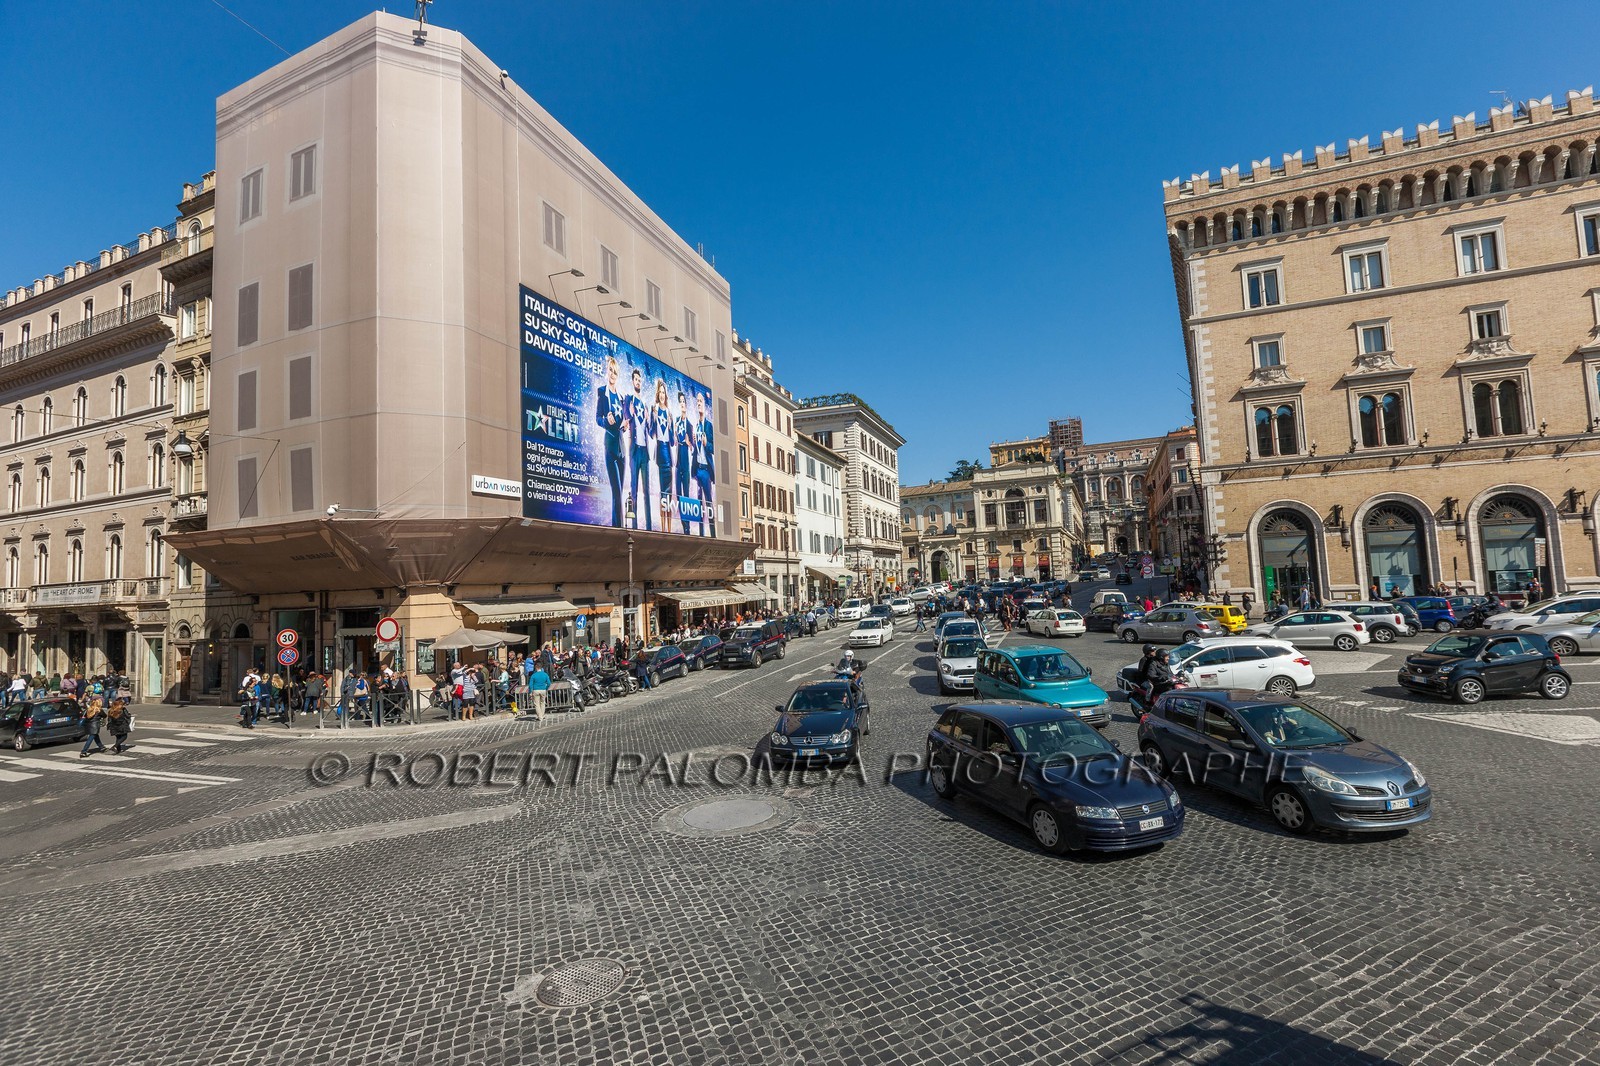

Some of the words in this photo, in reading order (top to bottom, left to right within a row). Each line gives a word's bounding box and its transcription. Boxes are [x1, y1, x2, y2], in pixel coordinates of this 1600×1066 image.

[525, 294, 565, 326] ITALIA'S
[566, 317, 586, 336] GOT
[587, 327, 618, 353] TALENT
[524, 312, 540, 330] SU
[541, 320, 562, 341] SKY
[563, 331, 588, 354] SARÀ
[525, 330, 574, 363] DAVVERO
[526, 440, 538, 452] Dal
[545, 446, 565, 458] marzo
[526, 452, 541, 464] ogni
[562, 460, 573, 470] alle
[526, 463, 536, 472] su
[535, 462, 548, 476] Sky
[547, 466, 561, 475] Uno
[571, 473, 589, 483] canale
[526, 479, 556, 493] Chiamaci
[555, 483, 580, 496] 02.7070
[533, 490, 548, 501] vieni
[548, 494, 557, 503] su
[661, 494, 680, 513] sky
[680, 501, 700, 518] UNO
[700, 505, 714, 520] HD
[532, 611, 555, 619] BRASILE
[281, 633, 294, 643] 30
